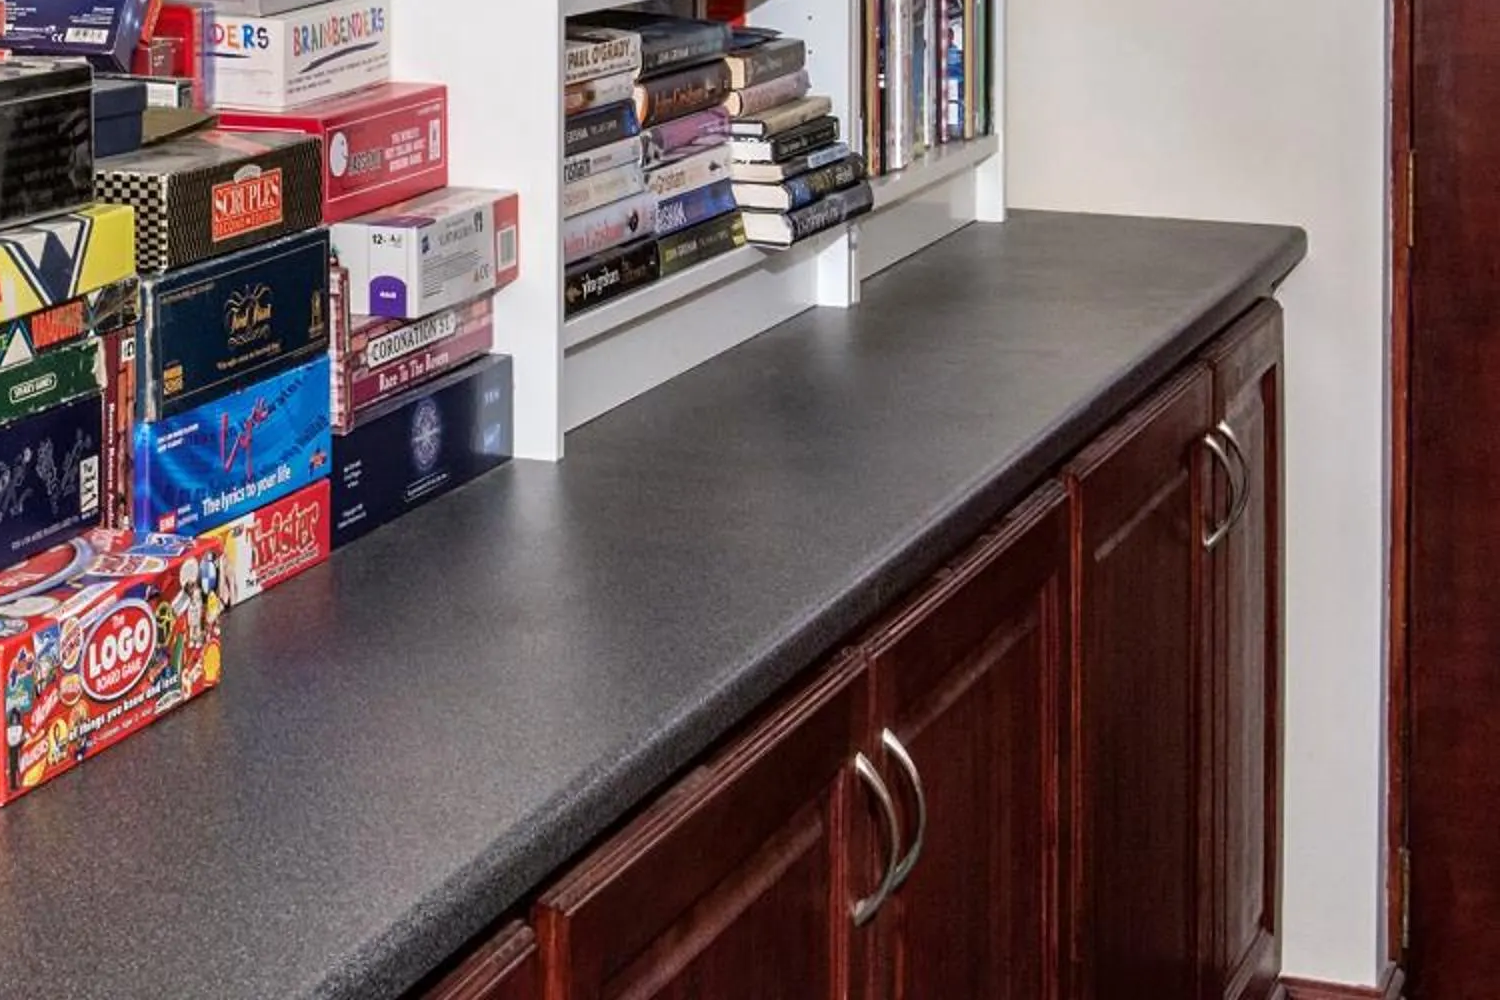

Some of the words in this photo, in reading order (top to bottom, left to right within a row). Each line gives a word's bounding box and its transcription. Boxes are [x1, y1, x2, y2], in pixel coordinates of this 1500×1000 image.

[370, 319, 437, 361] CORONATION
[202, 496, 222, 516] The
[89, 617, 150, 680] LOGO
